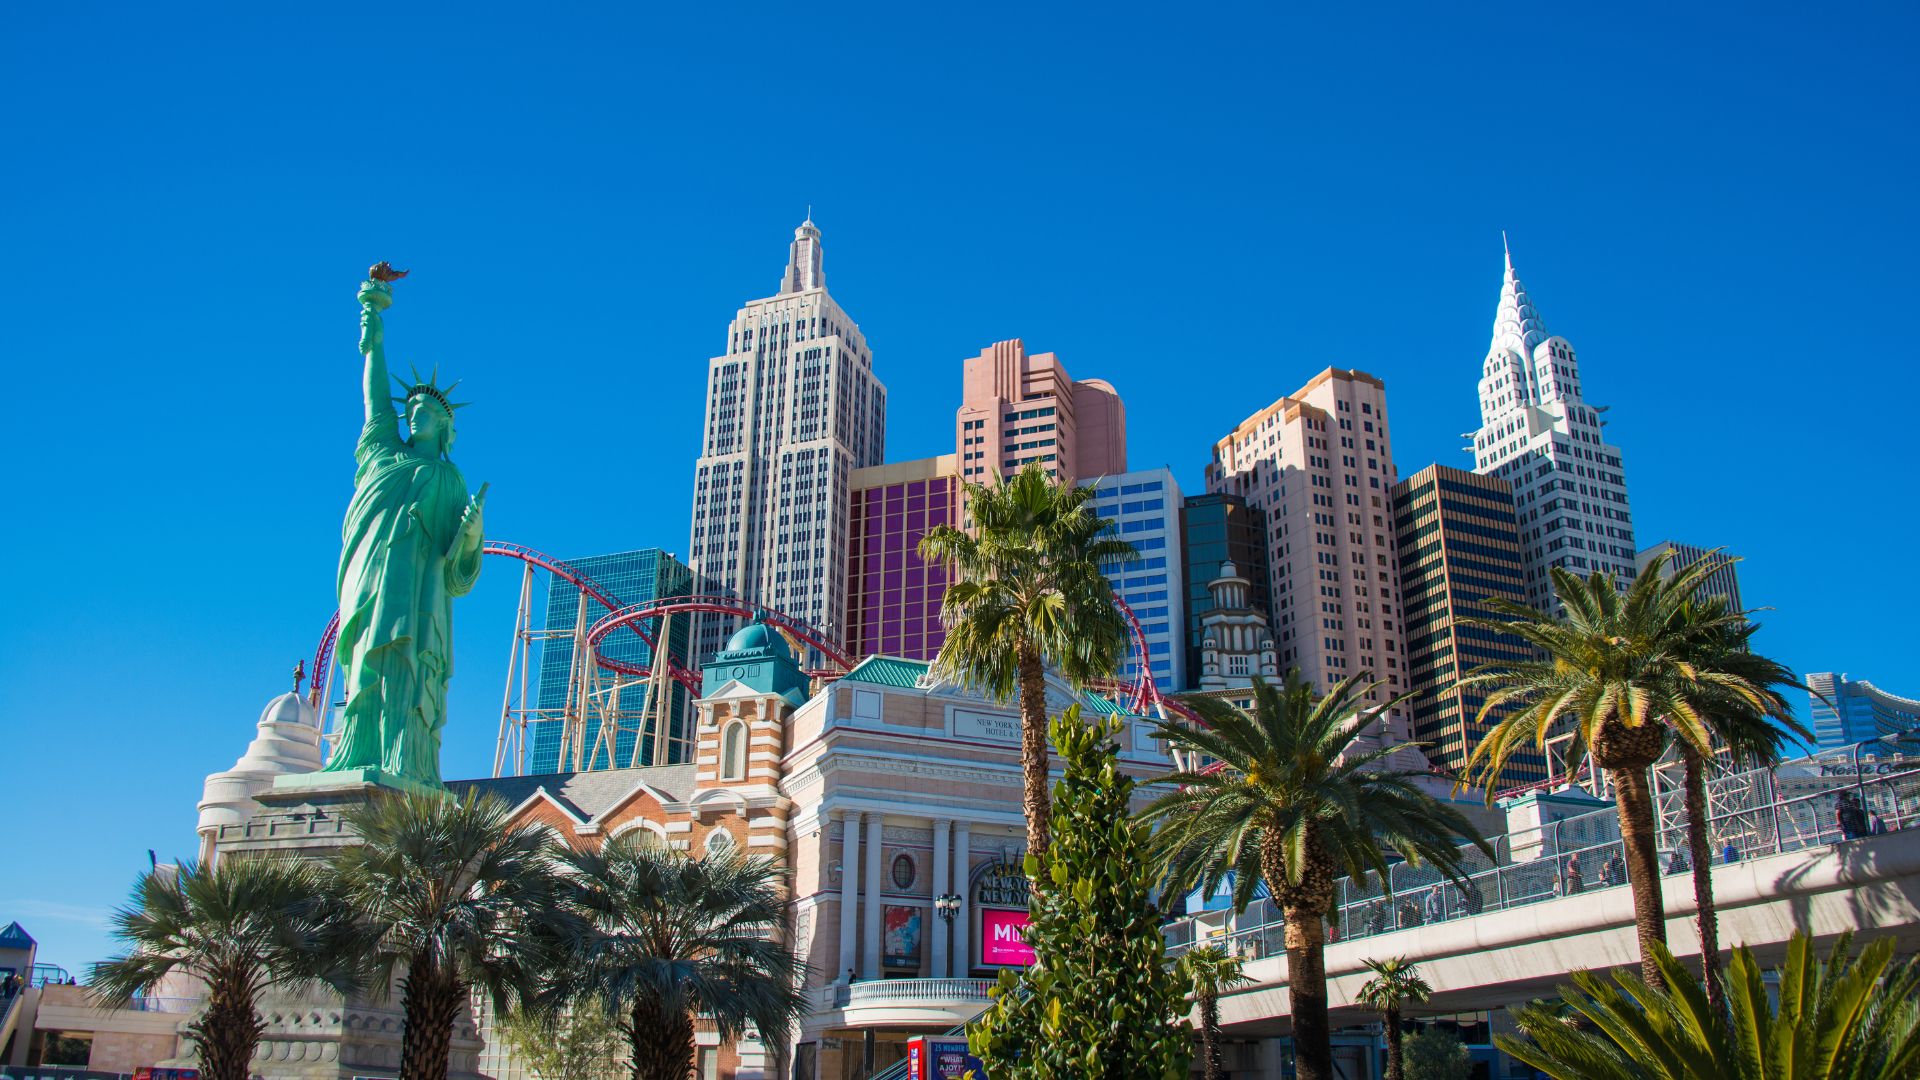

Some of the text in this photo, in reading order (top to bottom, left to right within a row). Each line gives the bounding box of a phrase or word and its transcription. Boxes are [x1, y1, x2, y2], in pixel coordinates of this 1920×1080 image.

[976, 718, 992, 727] NEW
[994, 720, 1013, 729] YORK
[985, 728, 1008, 737] HOTEL
[984, 873, 1012, 889] NEW
[984, 889, 1012, 903] NEW
